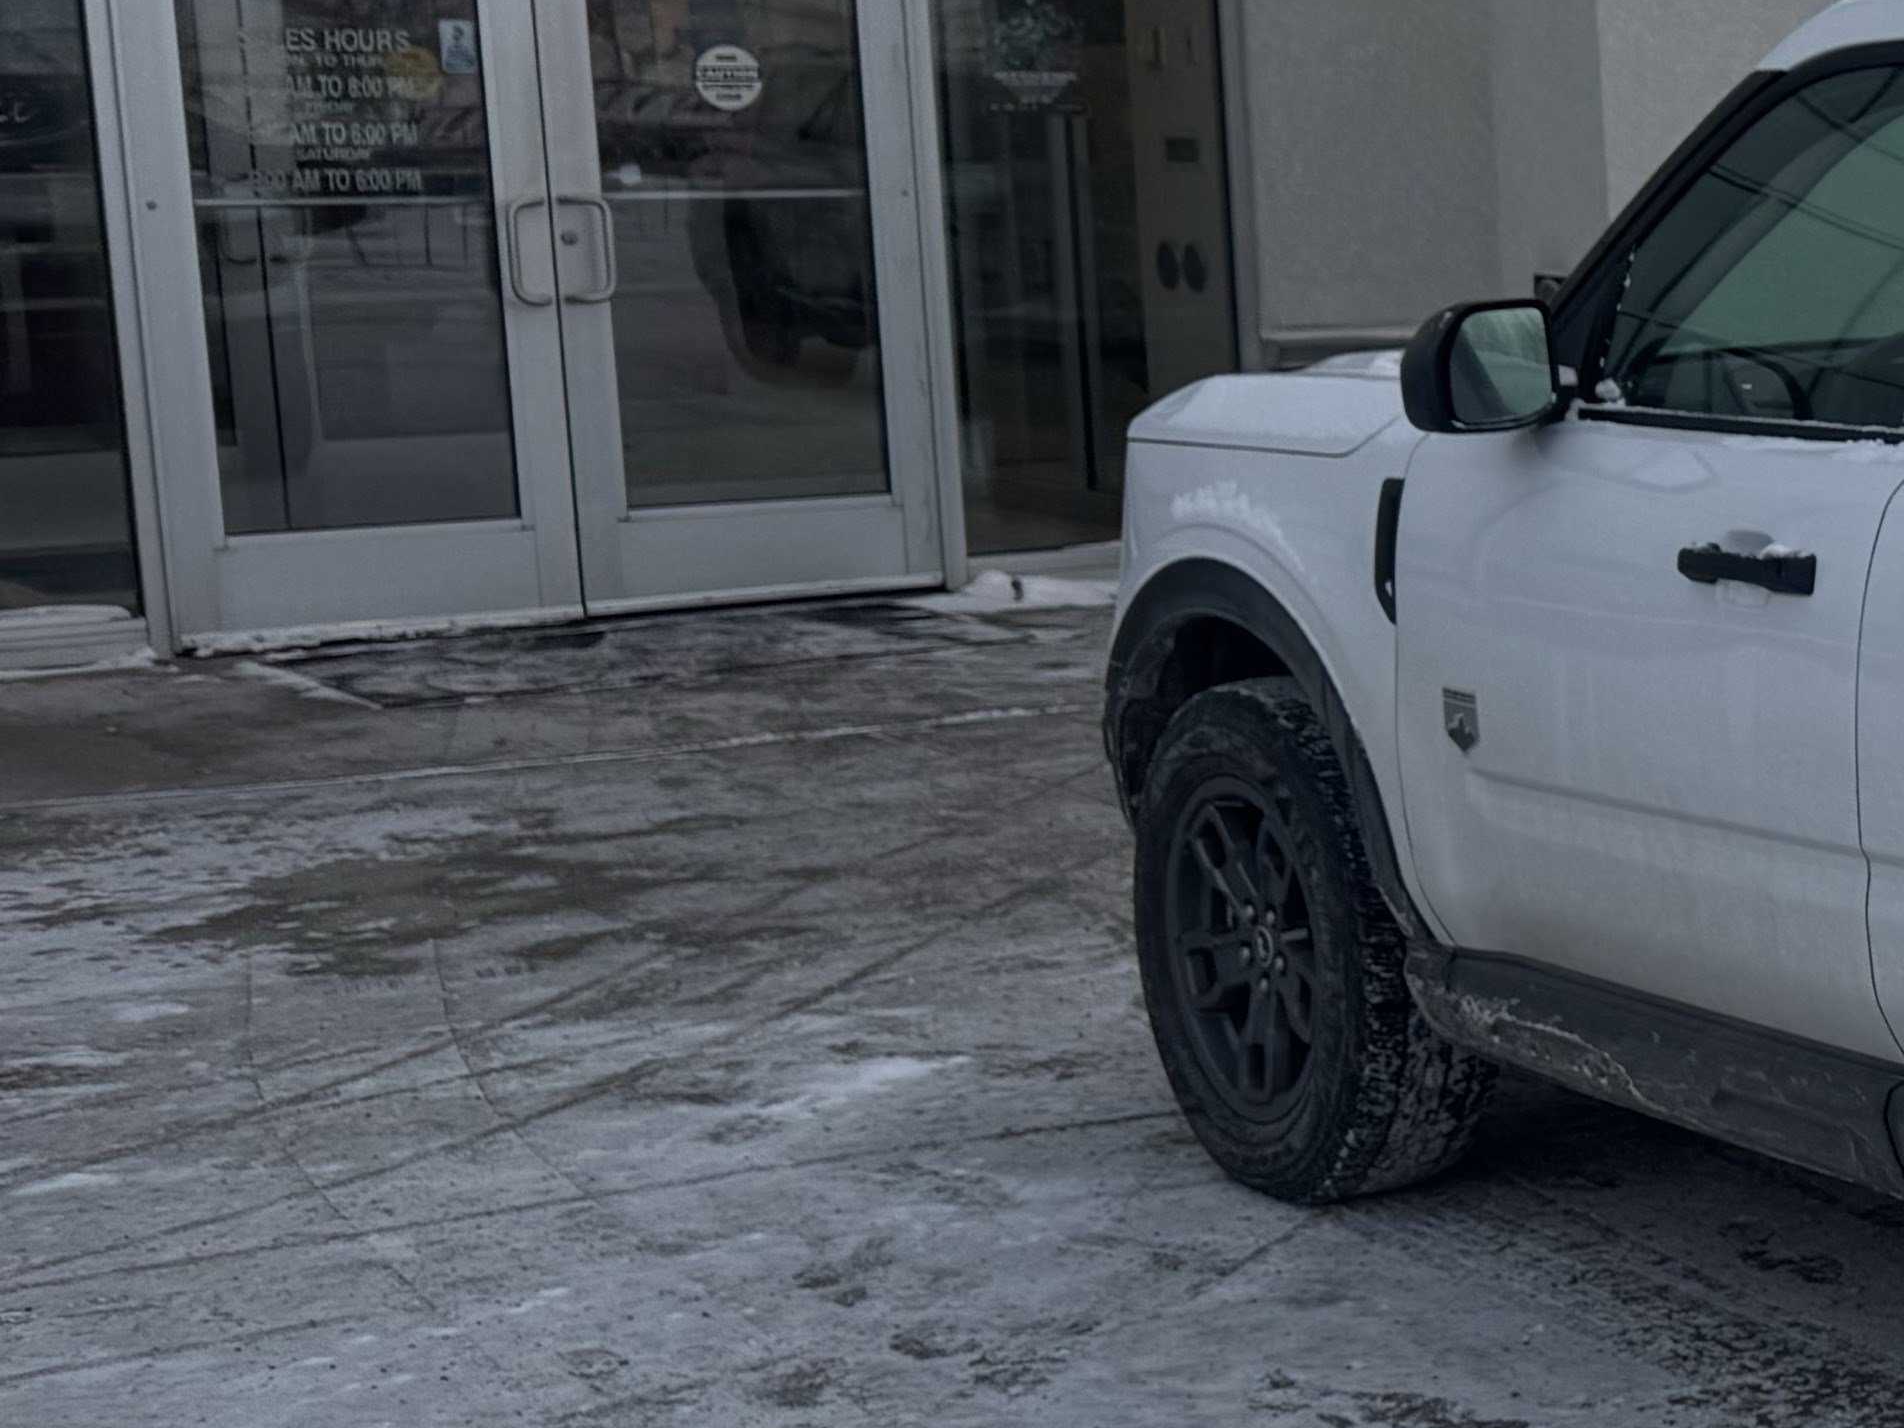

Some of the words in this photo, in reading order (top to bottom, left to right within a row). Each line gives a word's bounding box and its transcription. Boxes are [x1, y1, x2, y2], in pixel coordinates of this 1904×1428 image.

[324, 28, 412, 53] HOURS
[318, 74, 342, 98] TO
[292, 121, 318, 145] AM
[321, 121, 346, 145] TO
[390, 122, 419, 146] PM
[292, 168, 320, 190] AM
[324, 168, 350, 191] TO
[395, 169, 424, 192] PM
